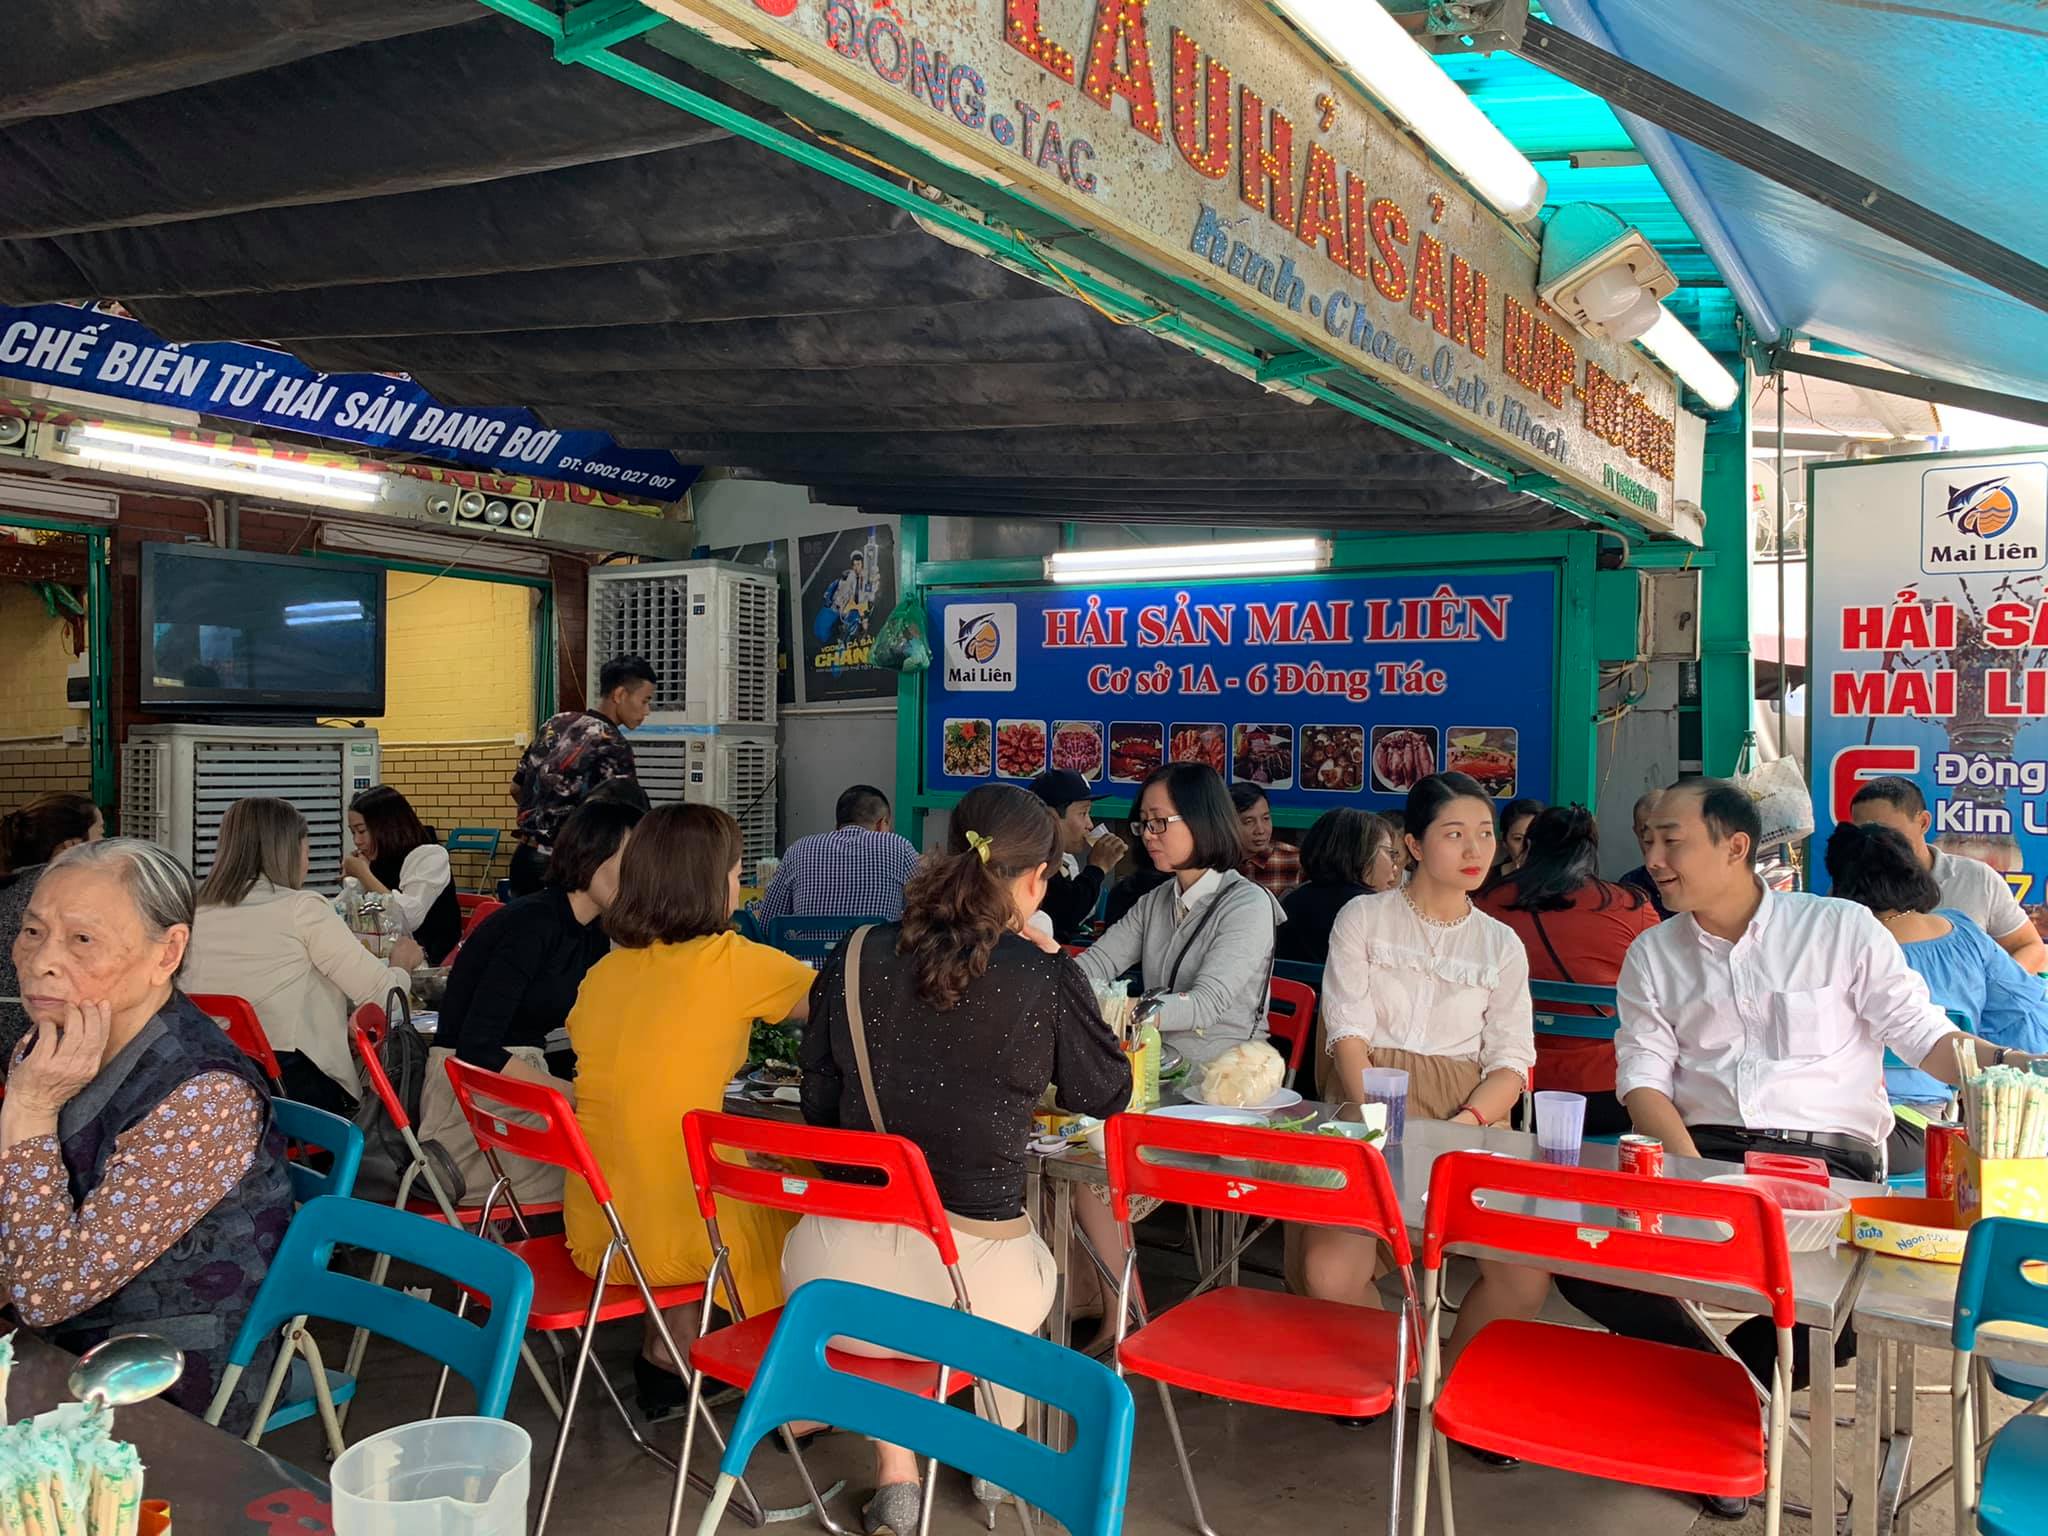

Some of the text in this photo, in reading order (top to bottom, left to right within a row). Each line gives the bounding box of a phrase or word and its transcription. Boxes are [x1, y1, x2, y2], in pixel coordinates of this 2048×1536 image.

[1, 323, 110, 377] CHẾ
[209, 361, 275, 407] TỪ
[334, 385, 415, 436] SẢN
[410, 407, 506, 454] ĐANG
[558, 456, 676, 490] ĐT: 0902 027 007
[1930, 543, 2038, 563] Mai Liên
[1042, 584, 1511, 648] HẢI SẢN MAI LIÊN
[1841, 590, 1957, 652] HẢI
[949, 667, 1012, 682] Mai Liên
[1088, 662, 1129, 693] Cơ
[1136, 661, 1170, 693] sở
[1182, 664, 1220, 693] 1A
[1246, 664, 1267, 693] 6
[1275, 661, 1368, 701] Đông
[1377, 661, 1447, 694] Tác
[1831, 670, 1958, 718] MAI
[1934, 752, 2047, 795] Đông
[1936, 800, 2011, 833] Kim
[1896, 1234, 1925, 1251] Ngon
